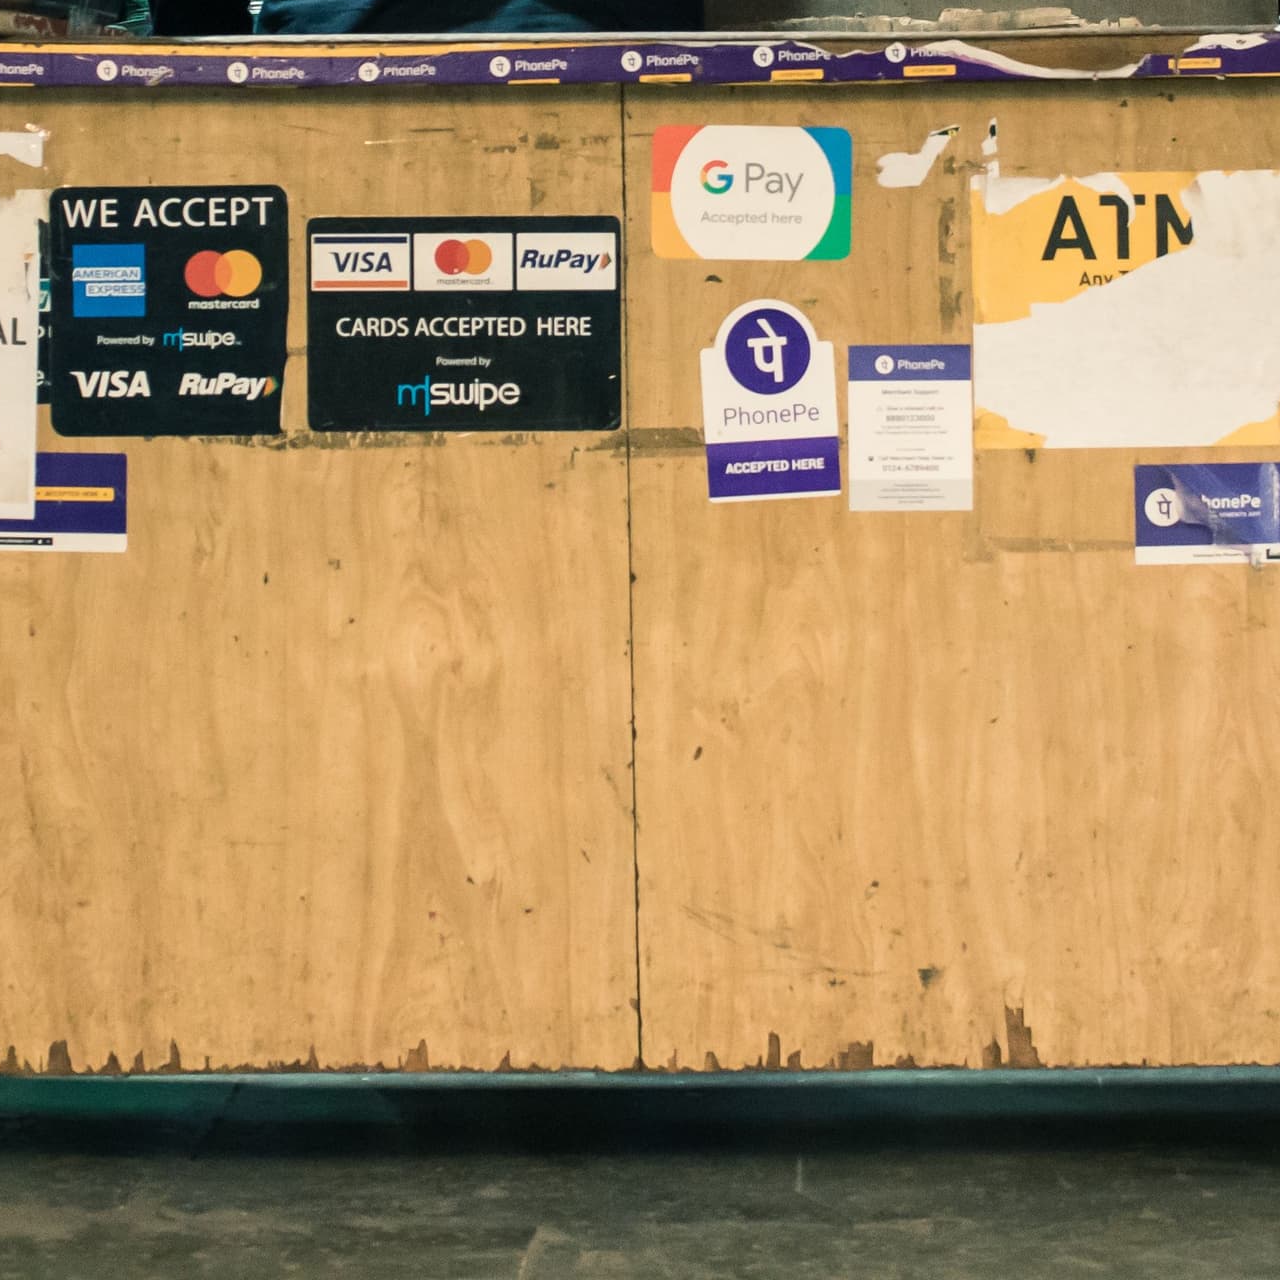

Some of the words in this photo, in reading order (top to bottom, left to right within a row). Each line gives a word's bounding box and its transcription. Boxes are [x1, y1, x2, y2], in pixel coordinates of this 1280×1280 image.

[646, 54, 699, 67] PhonePe
[778, 49, 832, 63] PhonePe
[383, 64, 436, 77] PhonePe
[514, 59, 568, 71] PhonePe
[252, 66, 305, 79] PhonePe
[699, 160, 734, 195] G
[744, 162, 804, 203] Pay
[62, 198, 119, 228] WE
[133, 197, 274, 227] ACCEPT
[700, 210, 767, 225] Accepted
[771, 210, 803, 225] here
[329, 251, 393, 273] VISA
[519, 248, 601, 274] RuPay
[73, 269, 140, 280] AMERICAN
[86, 284, 146, 295] EXPRESS
[188, 298, 260, 310] mastercard
[335, 317, 409, 337] CARDS
[414, 316, 527, 337] ACCEPTED
[536, 316, 592, 336] HERE
[96, 335, 140, 346] Powered
[142, 335, 155, 348] by
[435, 355, 472, 367] Powered
[474, 355, 492, 368] by
[897, 358, 946, 371] PhonePe
[69, 370, 151, 398] VISA
[178, 373, 267, 401] RuPay
[723, 402, 820, 427] PhonePe
[725, 458, 790, 475] ACCEPTED
[791, 456, 825, 471] HERE
